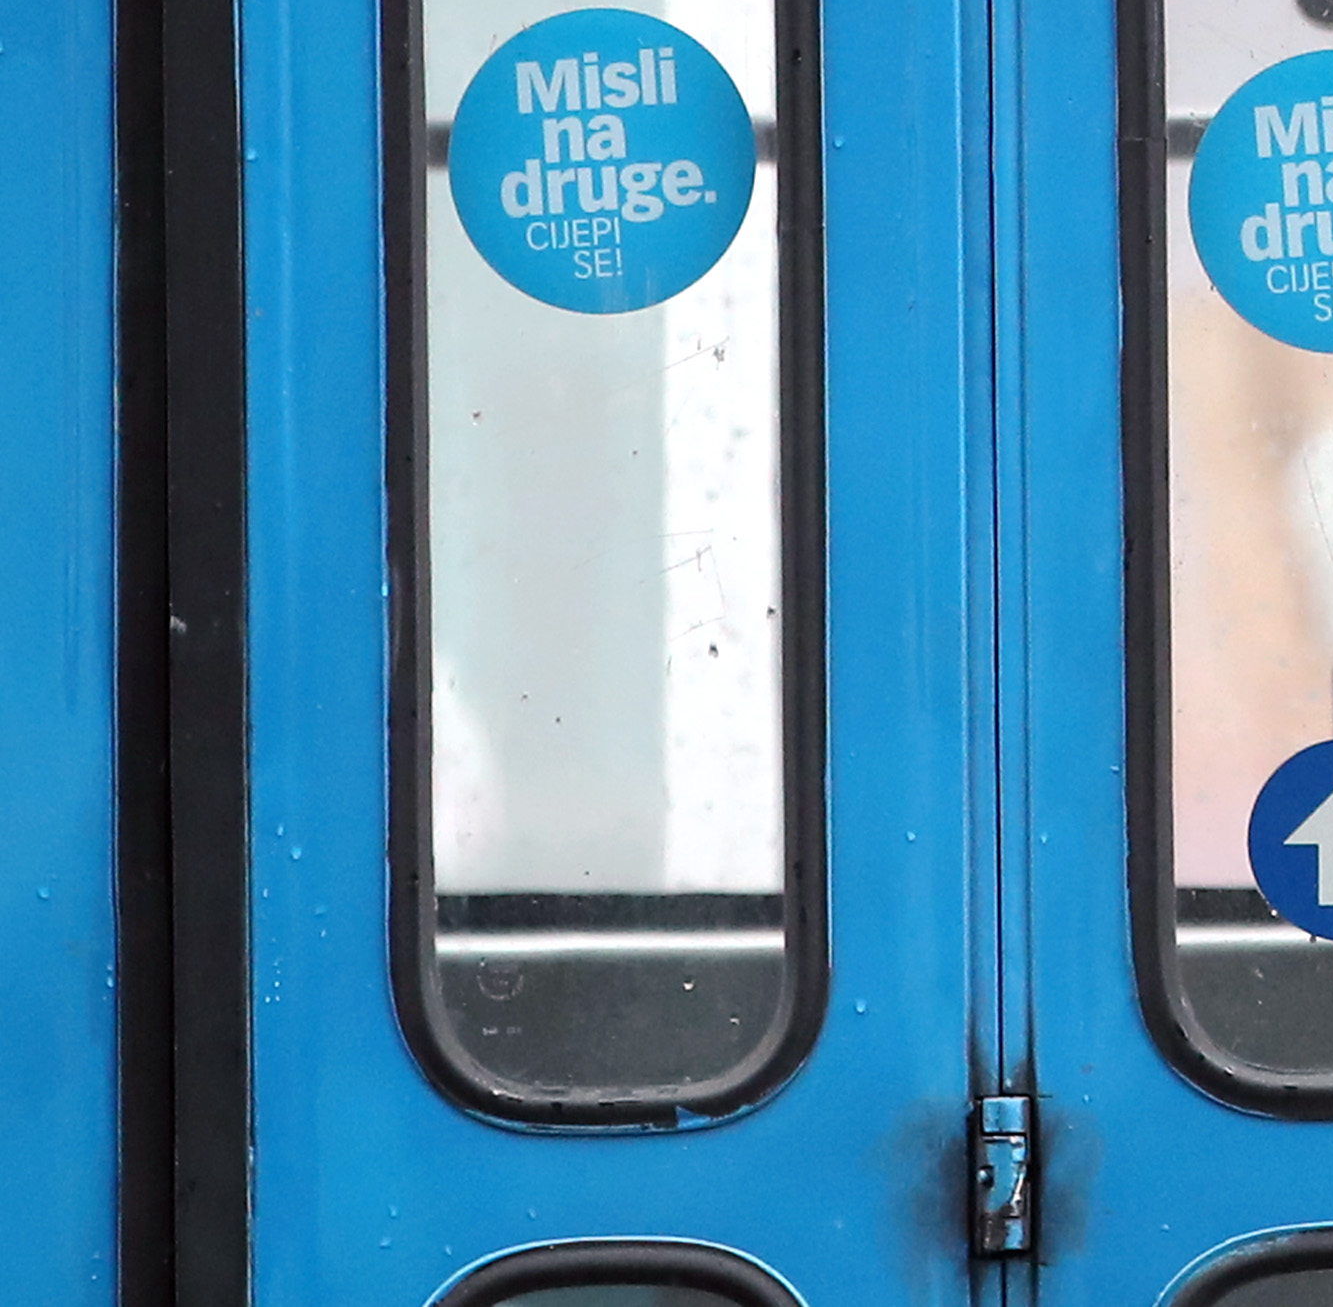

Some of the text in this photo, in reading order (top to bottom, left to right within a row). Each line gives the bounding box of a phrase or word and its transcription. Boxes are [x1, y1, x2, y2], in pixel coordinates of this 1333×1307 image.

[515, 46, 677, 114] Misli
[543, 114, 626, 163] na
[500, 157, 716, 223] druge.
[526, 217, 622, 252] CIJEPI
[573, 248, 623, 280] SE!
